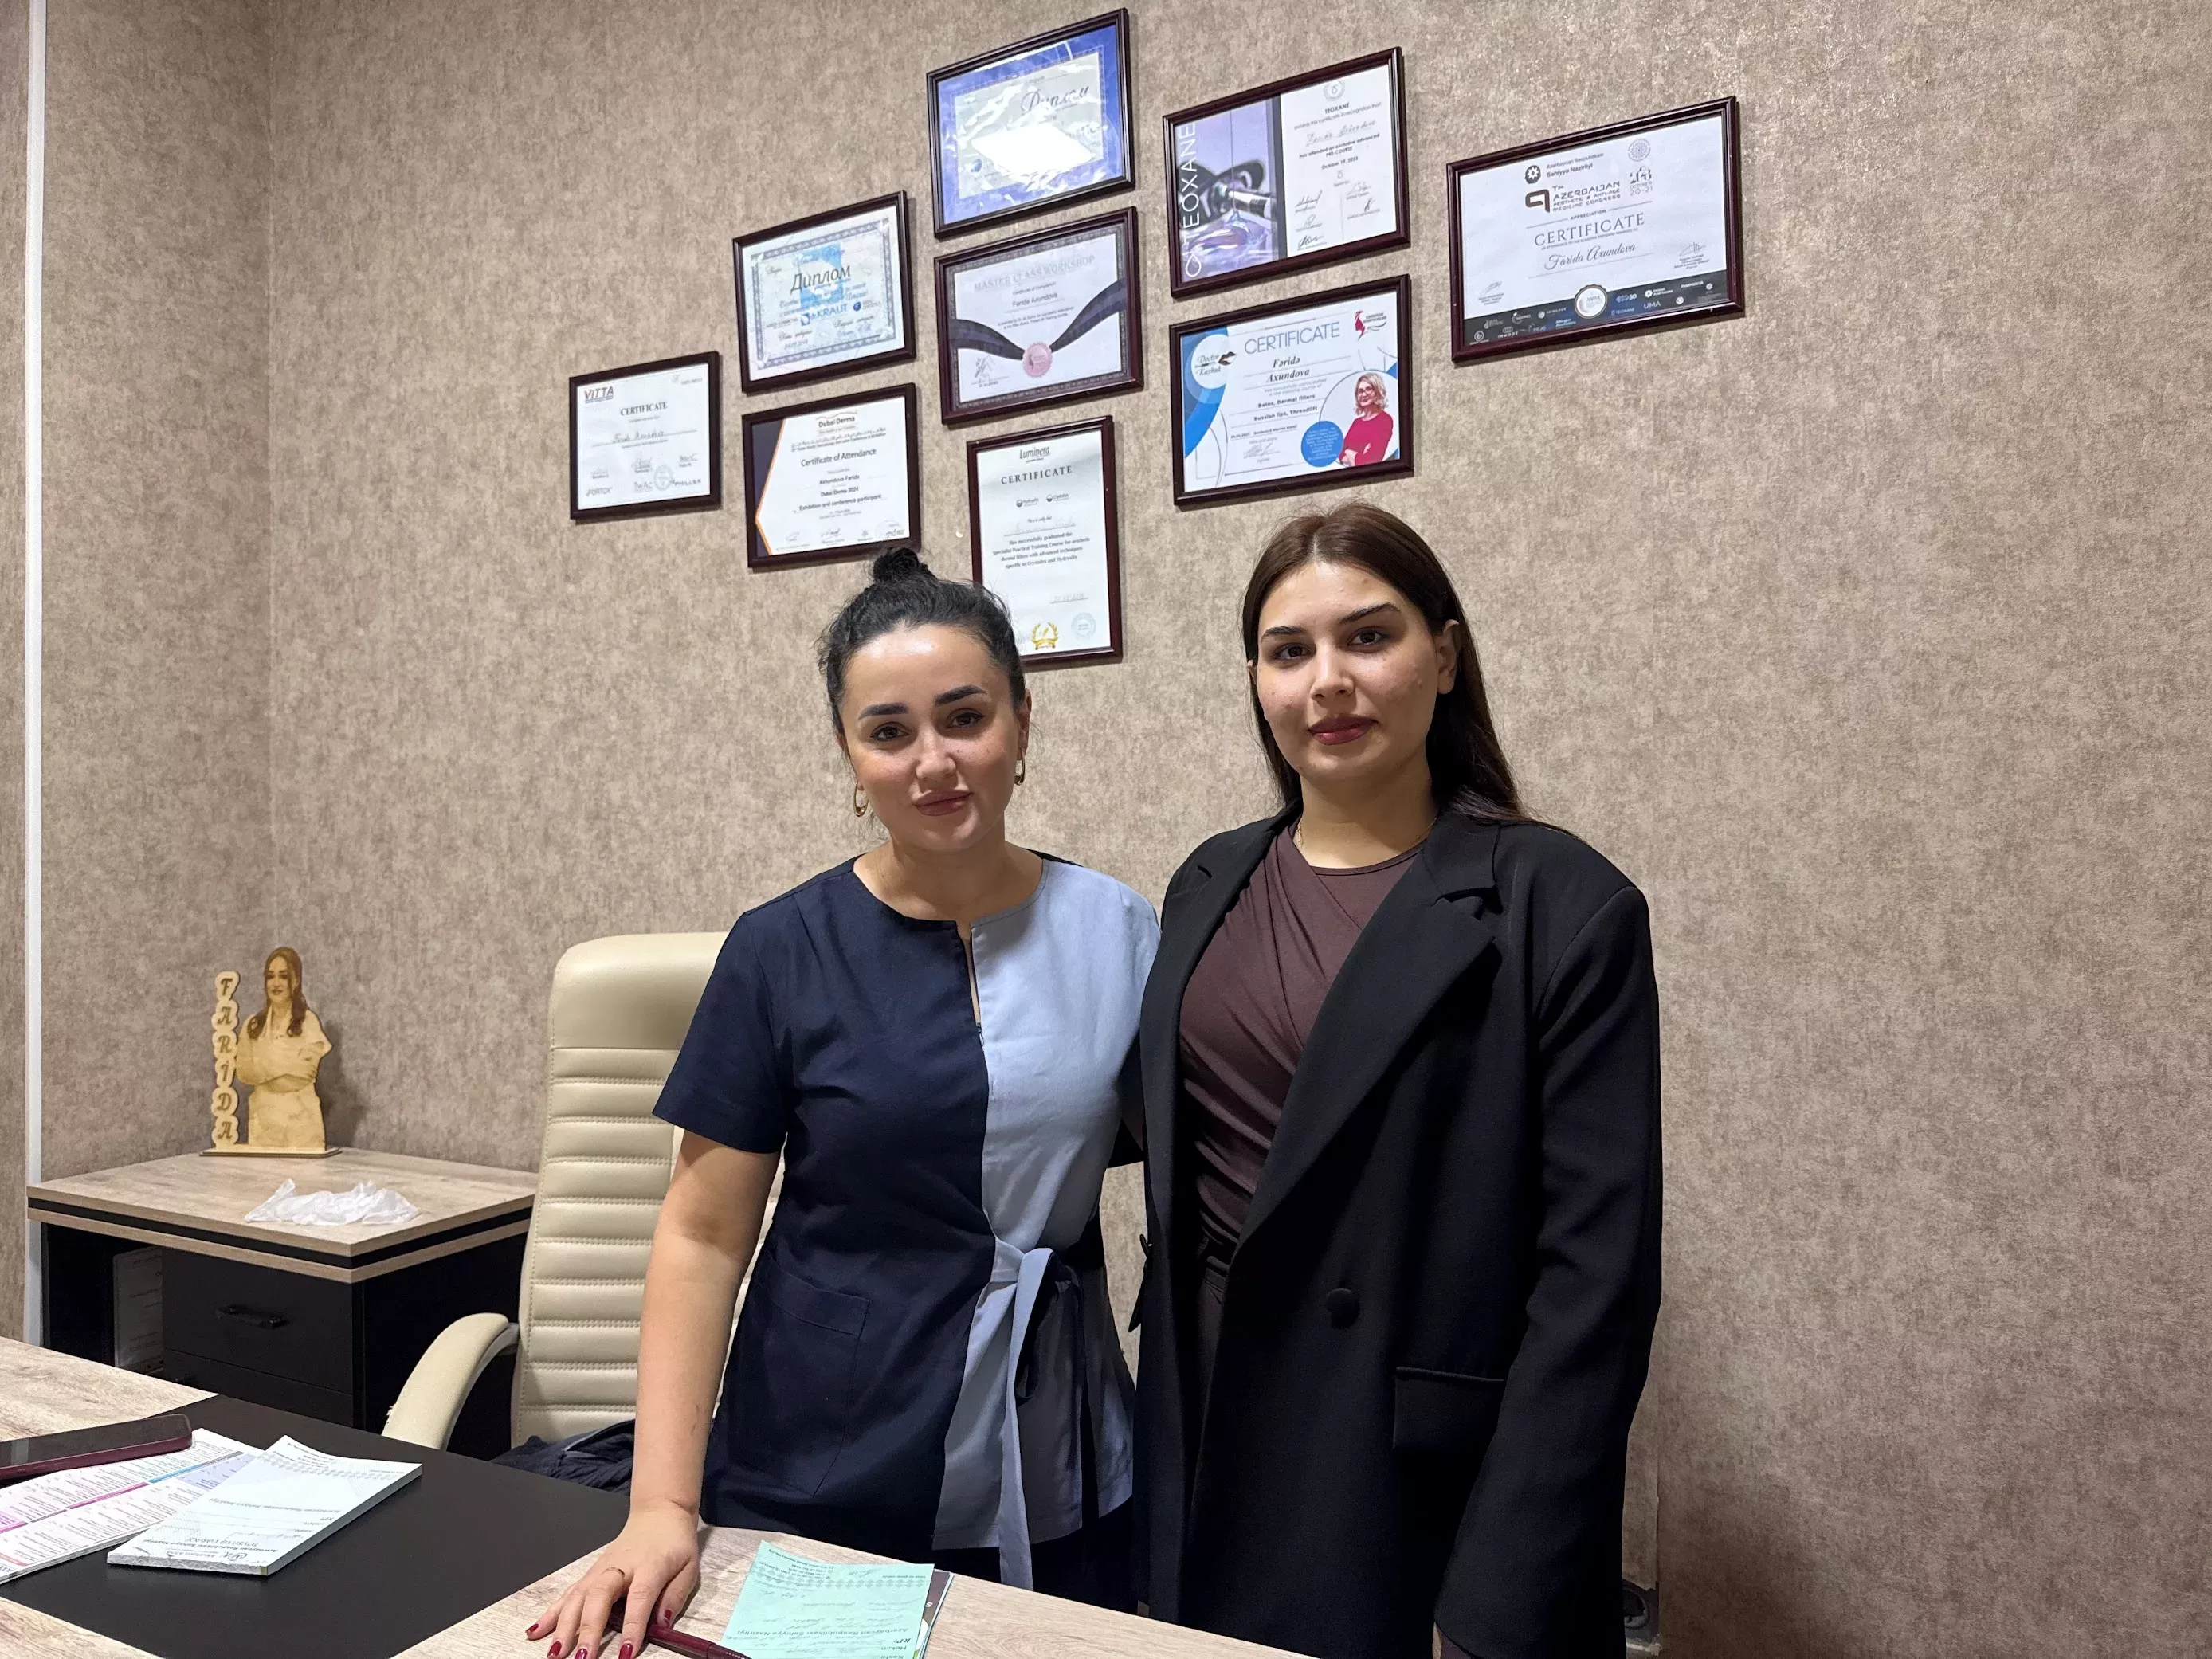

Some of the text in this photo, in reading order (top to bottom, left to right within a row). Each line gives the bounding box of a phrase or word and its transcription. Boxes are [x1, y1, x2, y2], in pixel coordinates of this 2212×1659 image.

[1324, 103, 1350, 114] TEOXANE
[1356, 133, 1380, 143] advanced
[1586, 194, 1621, 206] CONGRESS
[1570, 210, 1606, 221] APPRECIATION
[1534, 213, 1645, 246] CERTIFICATE
[1544, 242, 1636, 271] Farida Axundova
[1044, 254, 1095, 275] WORKSHOP
[790, 265, 852, 296] Диплом
[1644, 300, 1661, 309] UMA
[1245, 321, 1340, 355] CERTIFICATE
[1266, 369, 1310, 383] Axundova
[585, 386, 614, 399] VITTA
[620, 401, 668, 416] CERTIFICATE
[1277, 397, 1297, 406] Dermal
[818, 416, 856, 428] Dubai Derma
[801, 456, 833, 467] Certificate
[841, 448, 877, 460] Attendance
[1019, 445, 1051, 460] Luminera
[1001, 465, 1073, 484] CERTIFICATE
[799, 502, 822, 512] Exhibition
[832, 497, 856, 506] conference
[857, 492, 882, 504] participant
[1044, 531, 1065, 542] graduated
